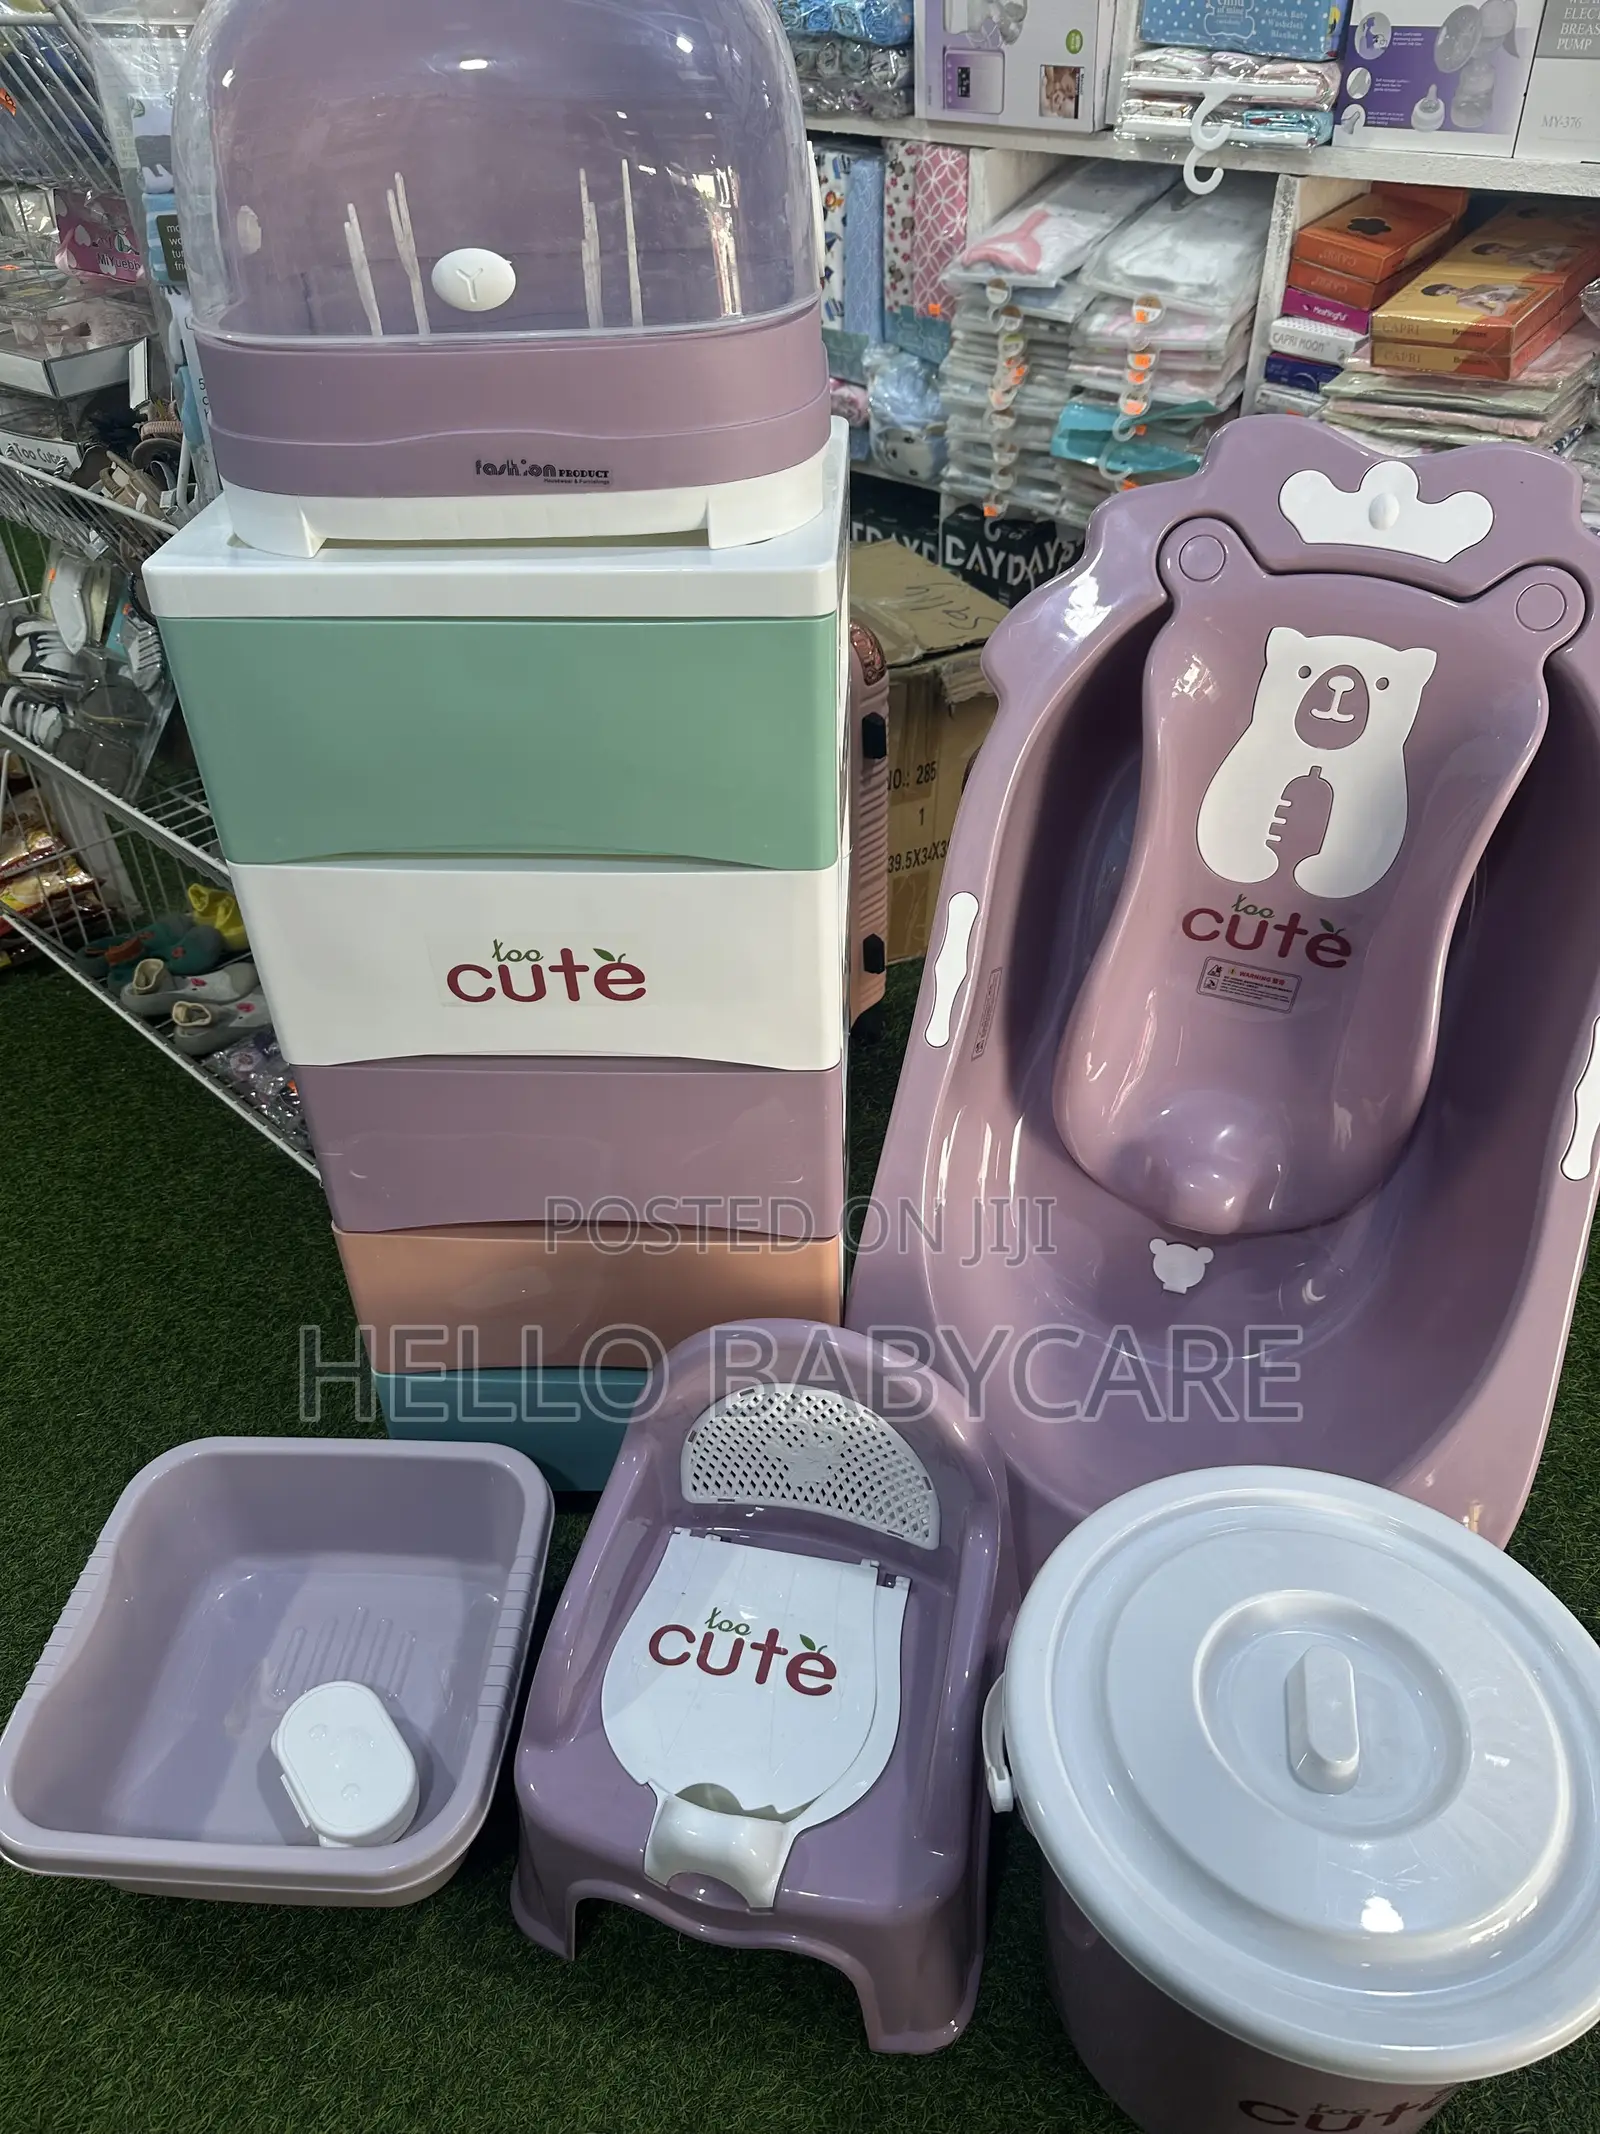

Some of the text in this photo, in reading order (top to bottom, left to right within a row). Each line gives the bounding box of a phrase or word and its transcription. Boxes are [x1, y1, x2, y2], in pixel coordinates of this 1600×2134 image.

[1557, 37, 1592, 51] PUMP
[1541, 114, 1582, 128] MY-376
[1382, 321, 1420, 336] CAPRI
[475, 459, 610, 479] fashion PRODUCT
[916, 760, 936, 785] 285
[919, 806, 925, 827] 1
[887, 838, 950, 873] 39.5X34X3
[1231, 893, 1276, 919] too
[491, 938, 545, 963] too
[1182, 907, 1353, 969] cute
[446, 947, 647, 1003] cute
[1239, 971, 1272, 983] WARNING
[704, 1606, 752, 1637] too
[648, 1623, 838, 1697] cute
